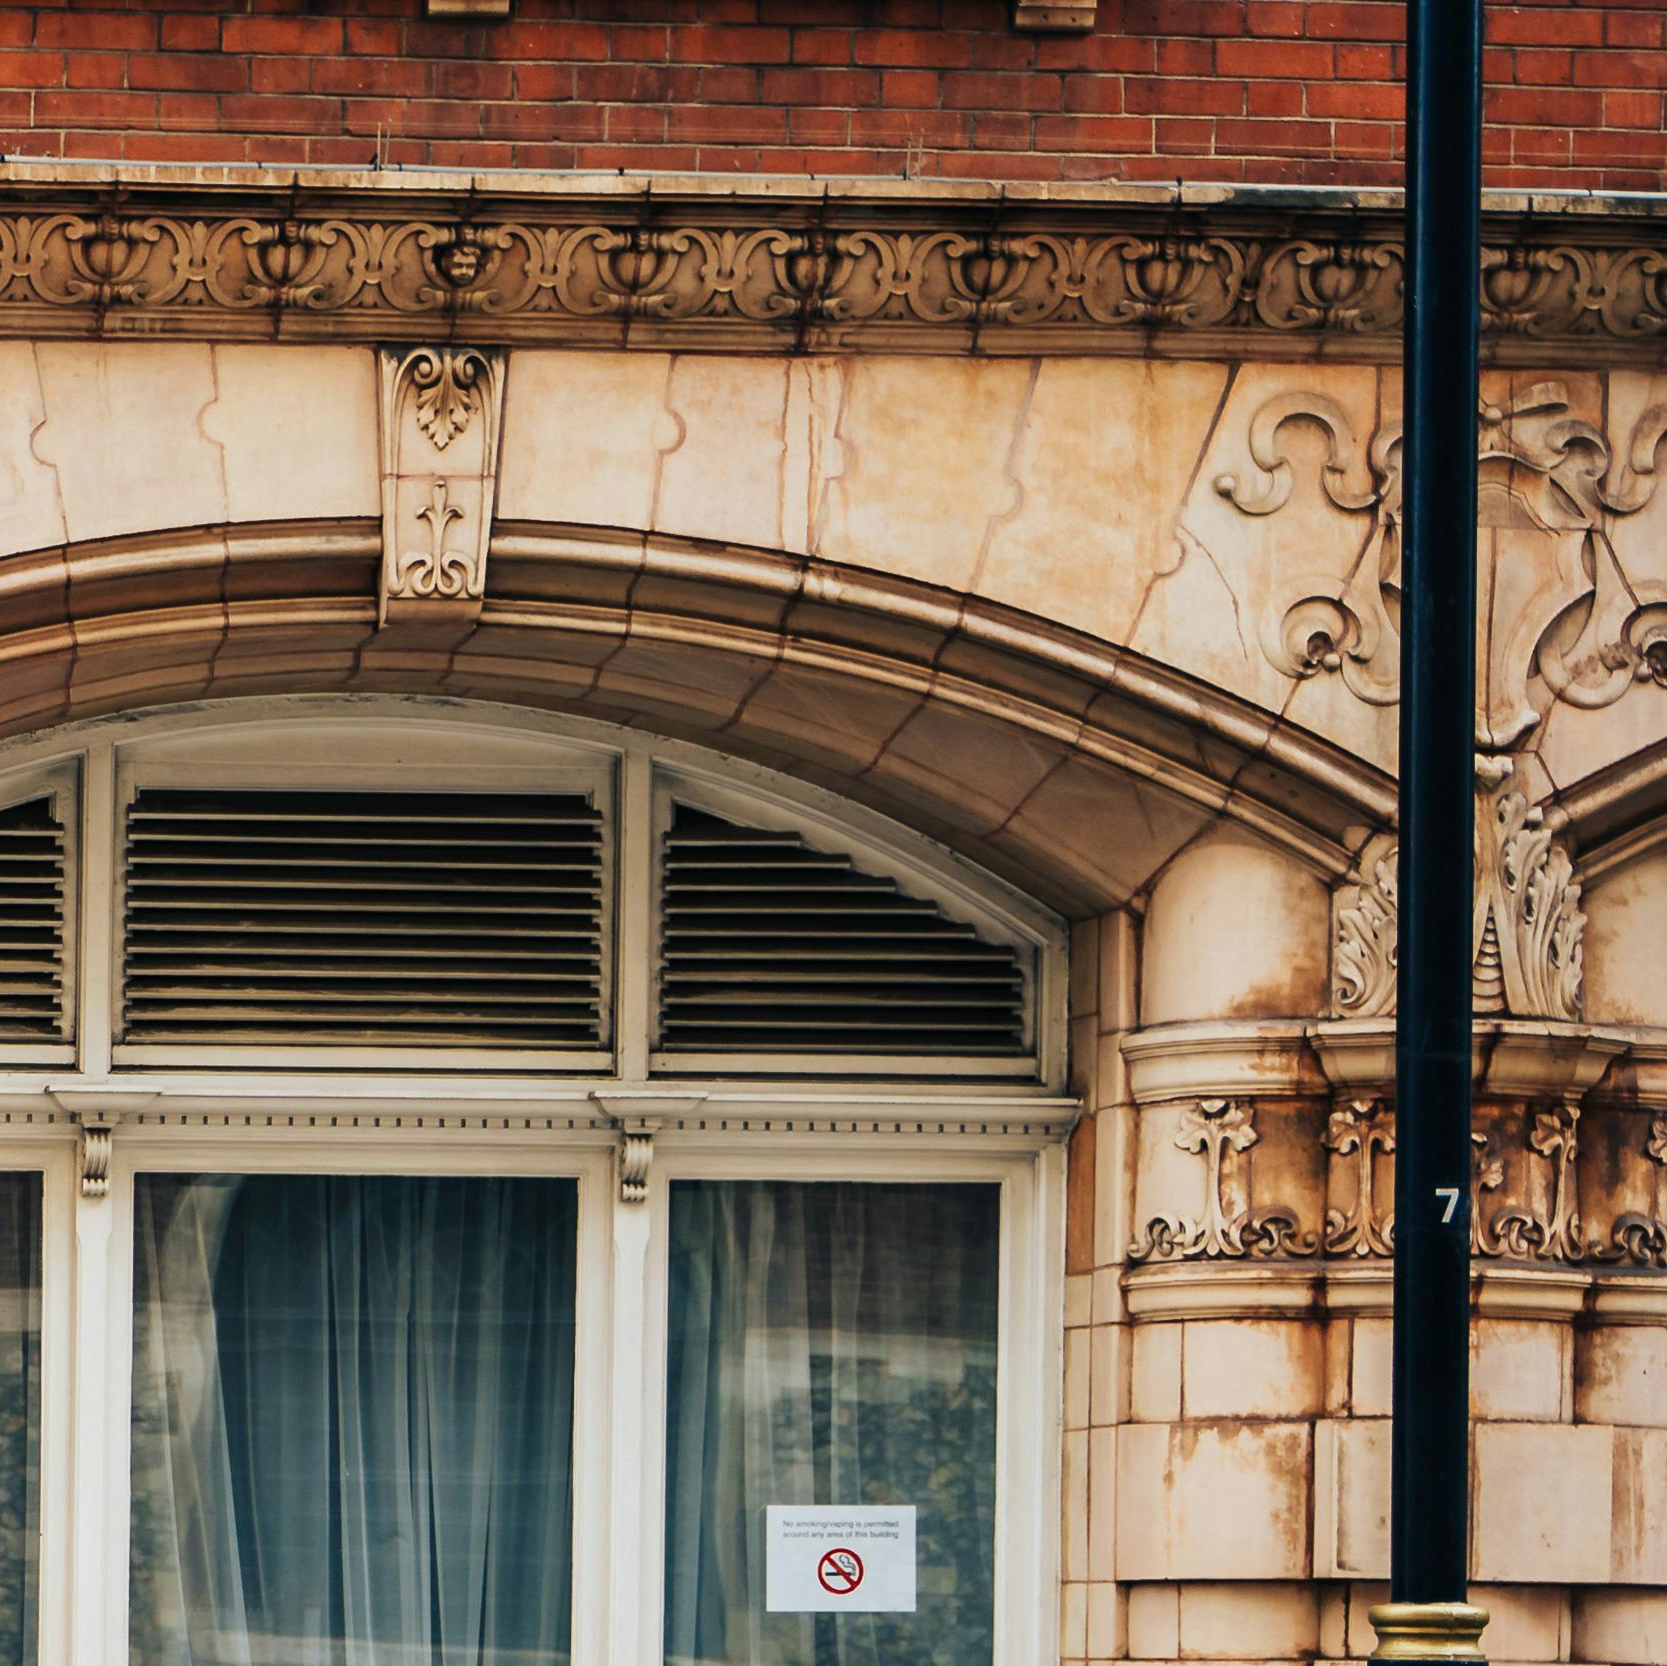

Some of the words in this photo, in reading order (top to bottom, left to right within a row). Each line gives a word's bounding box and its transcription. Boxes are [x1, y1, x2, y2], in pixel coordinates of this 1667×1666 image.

[1435, 1188, 1459, 1223] 7
[782, 1520, 794, 1528] No
[796, 1520, 854, 1529] smoking/vaping
[856, 1520, 862, 1528] is
[864, 1520, 899, 1529] permitted
[783, 1531, 809, 1539] around
[811, 1532, 824, 1540] any
[845, 1531, 854, 1539] of
[855, 1531, 868, 1539] this
[869, 1531, 900, 1540] building
